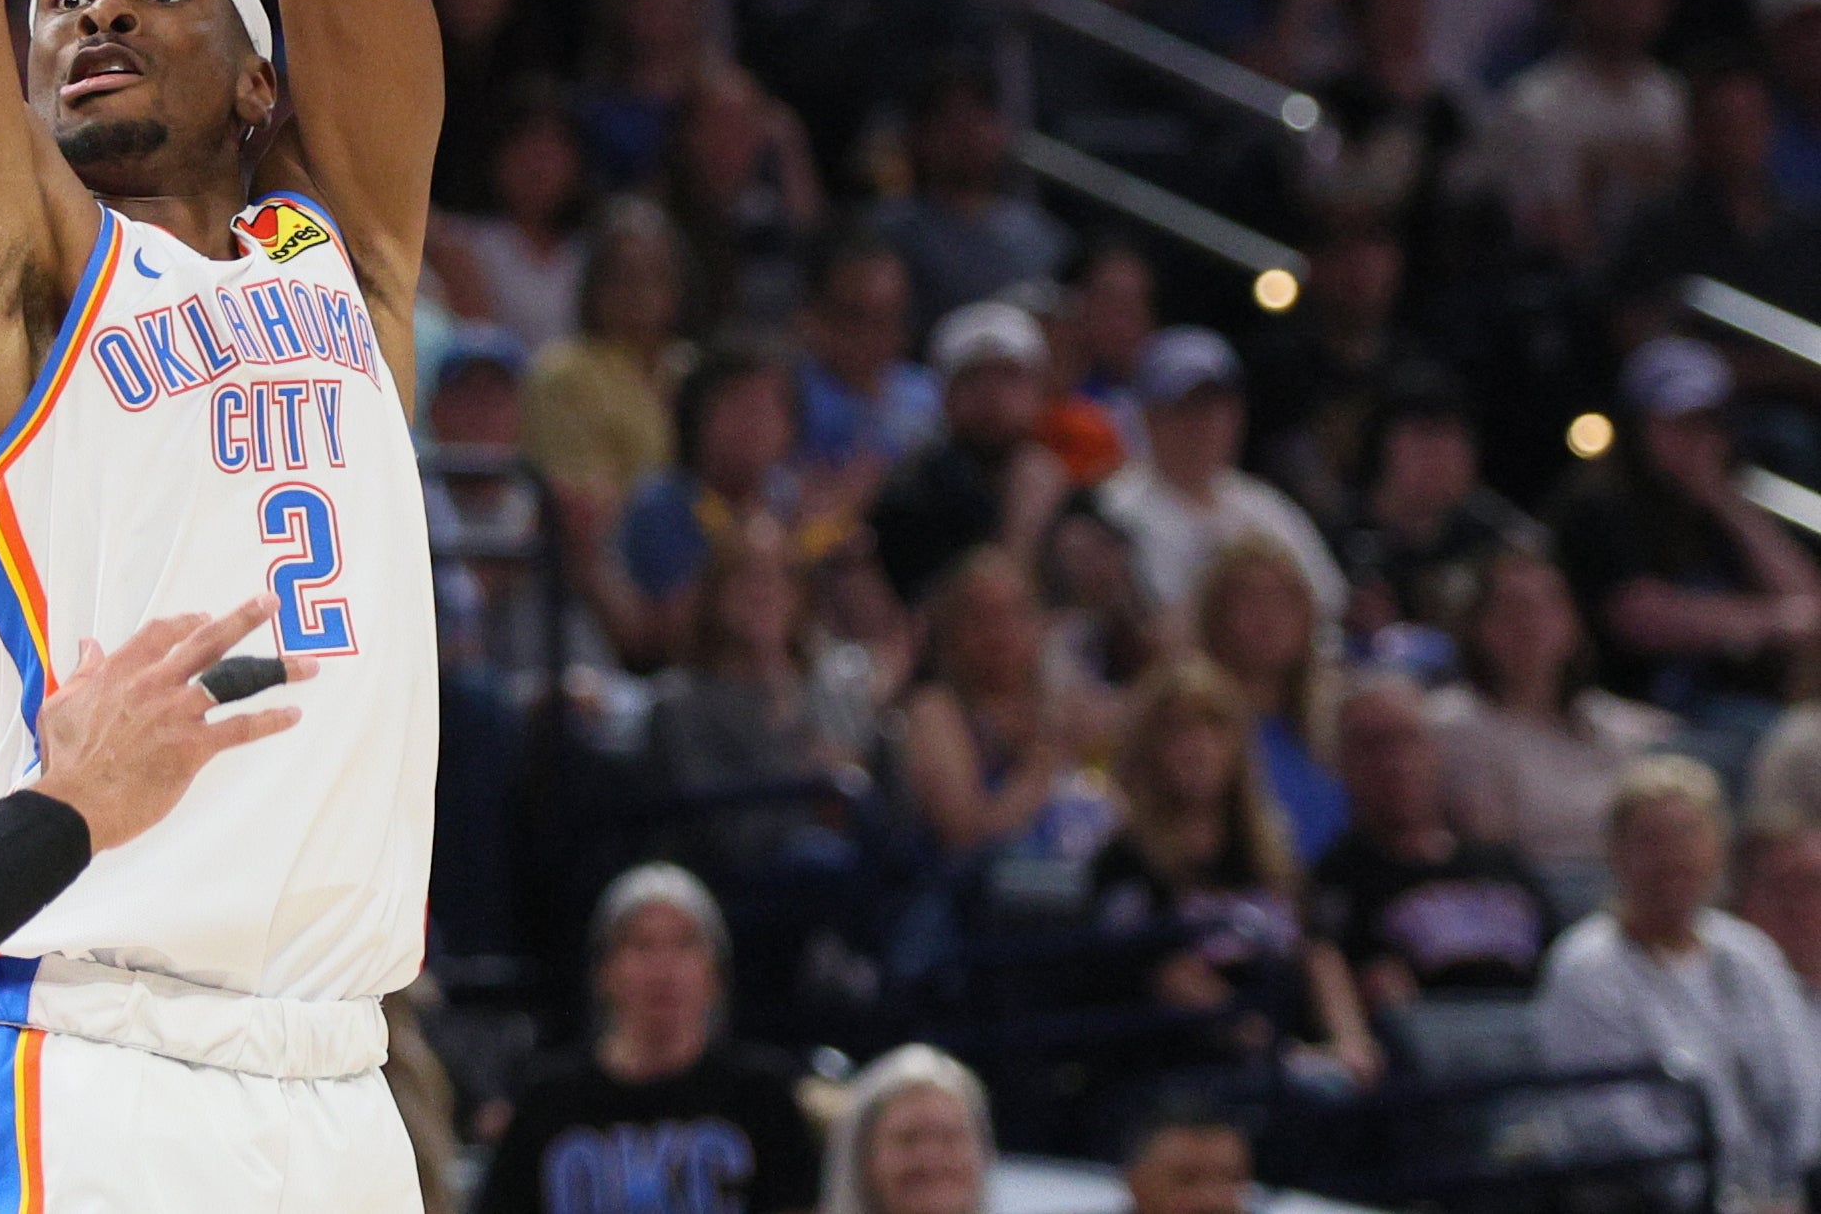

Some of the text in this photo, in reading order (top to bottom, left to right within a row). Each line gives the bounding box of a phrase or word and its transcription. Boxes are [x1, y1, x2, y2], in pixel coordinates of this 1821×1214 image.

[91, 277, 382, 413] OKLAHOMA
[210, 379, 347, 474] CITY
[257, 481, 359, 657] 2
